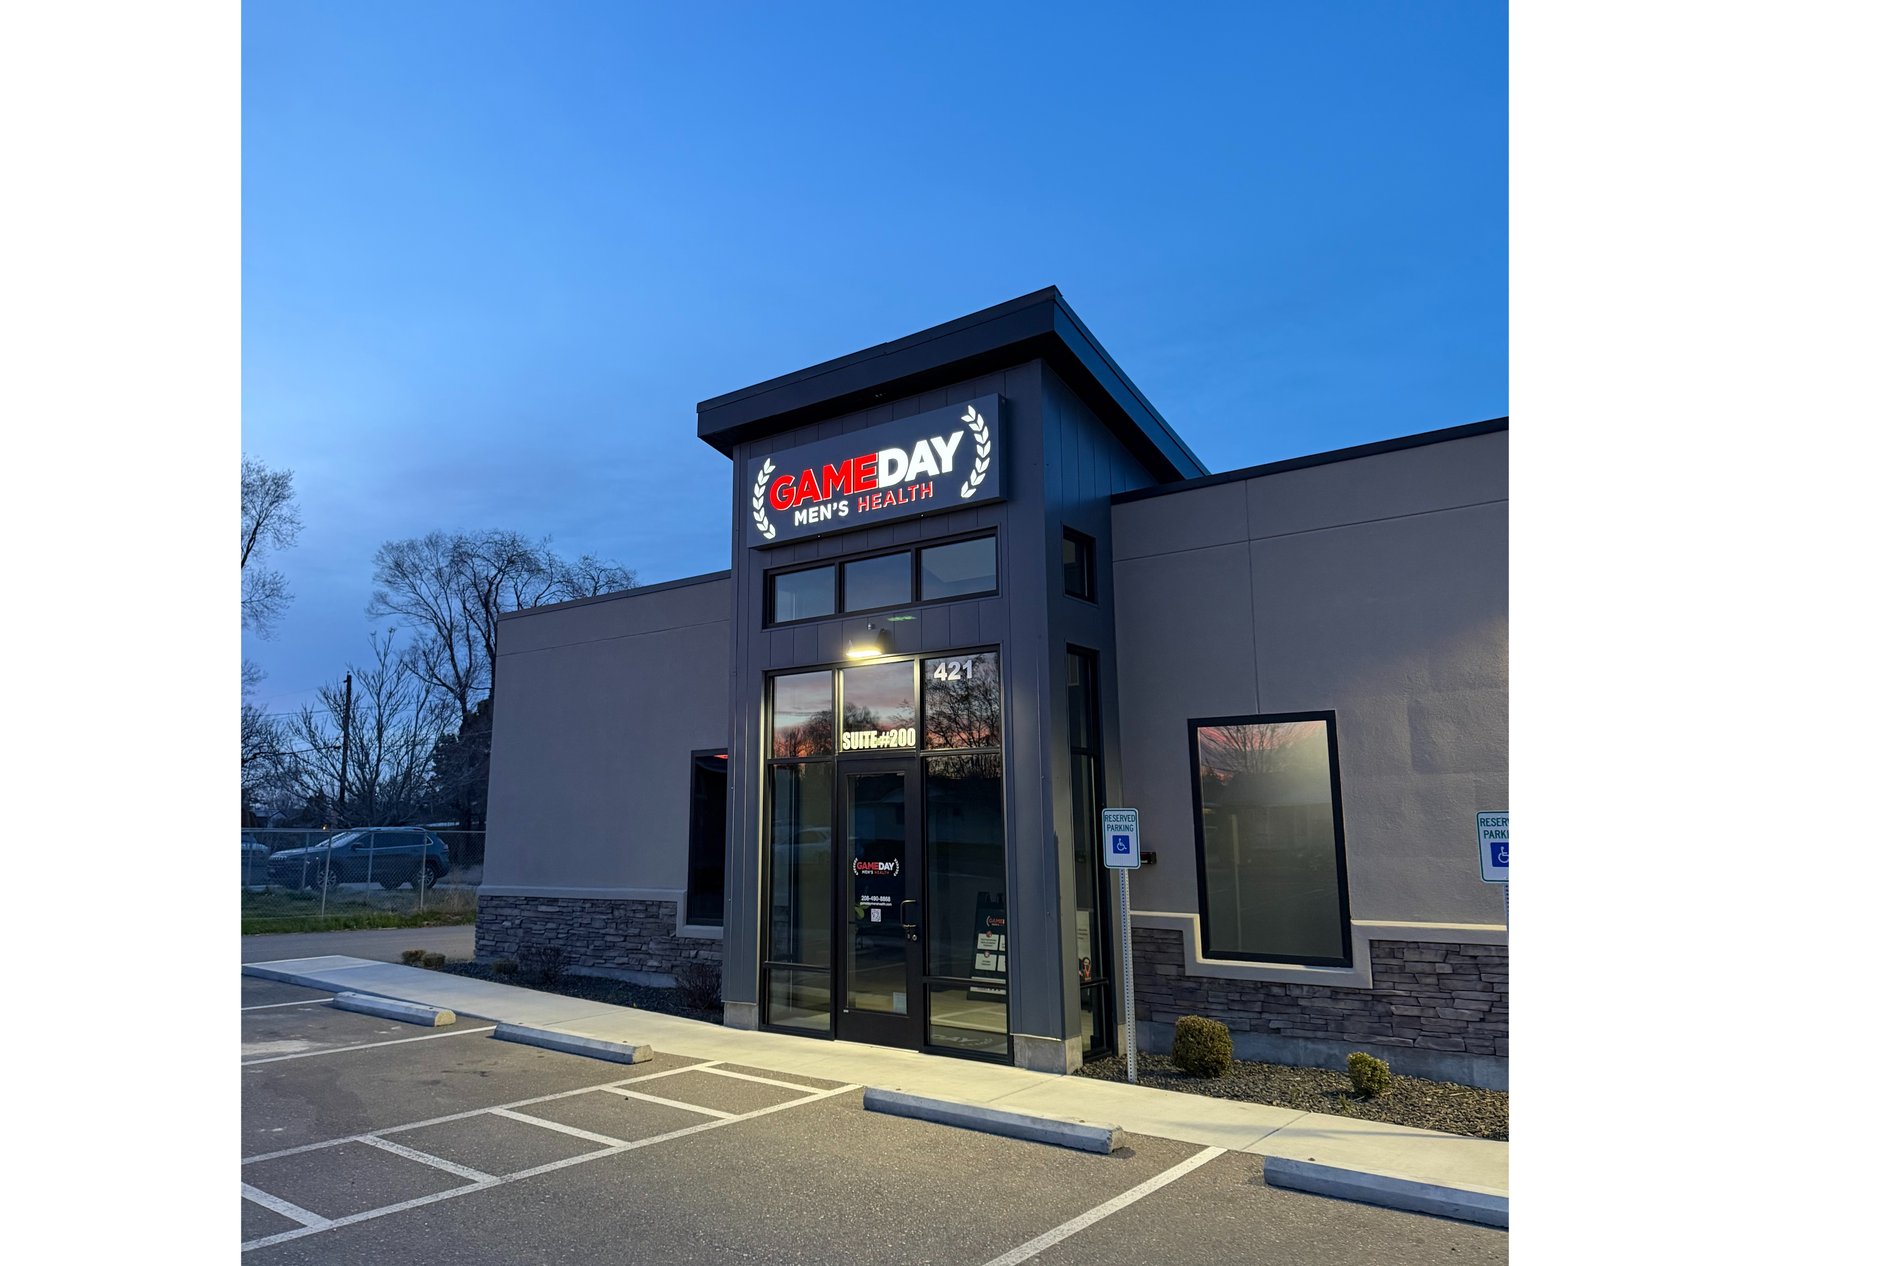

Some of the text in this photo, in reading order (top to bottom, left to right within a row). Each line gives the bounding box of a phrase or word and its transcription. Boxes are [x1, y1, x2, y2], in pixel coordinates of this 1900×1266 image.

[769, 430, 964, 511] GAMEDAY
[794, 481, 933, 527] MEN'S HEALTH
[933, 659, 974, 681] 421
[1104, 814, 1136, 823] RESERVED
[1107, 824, 1134, 832] PARKING
[856, 861, 895, 871] GAMEDAY
